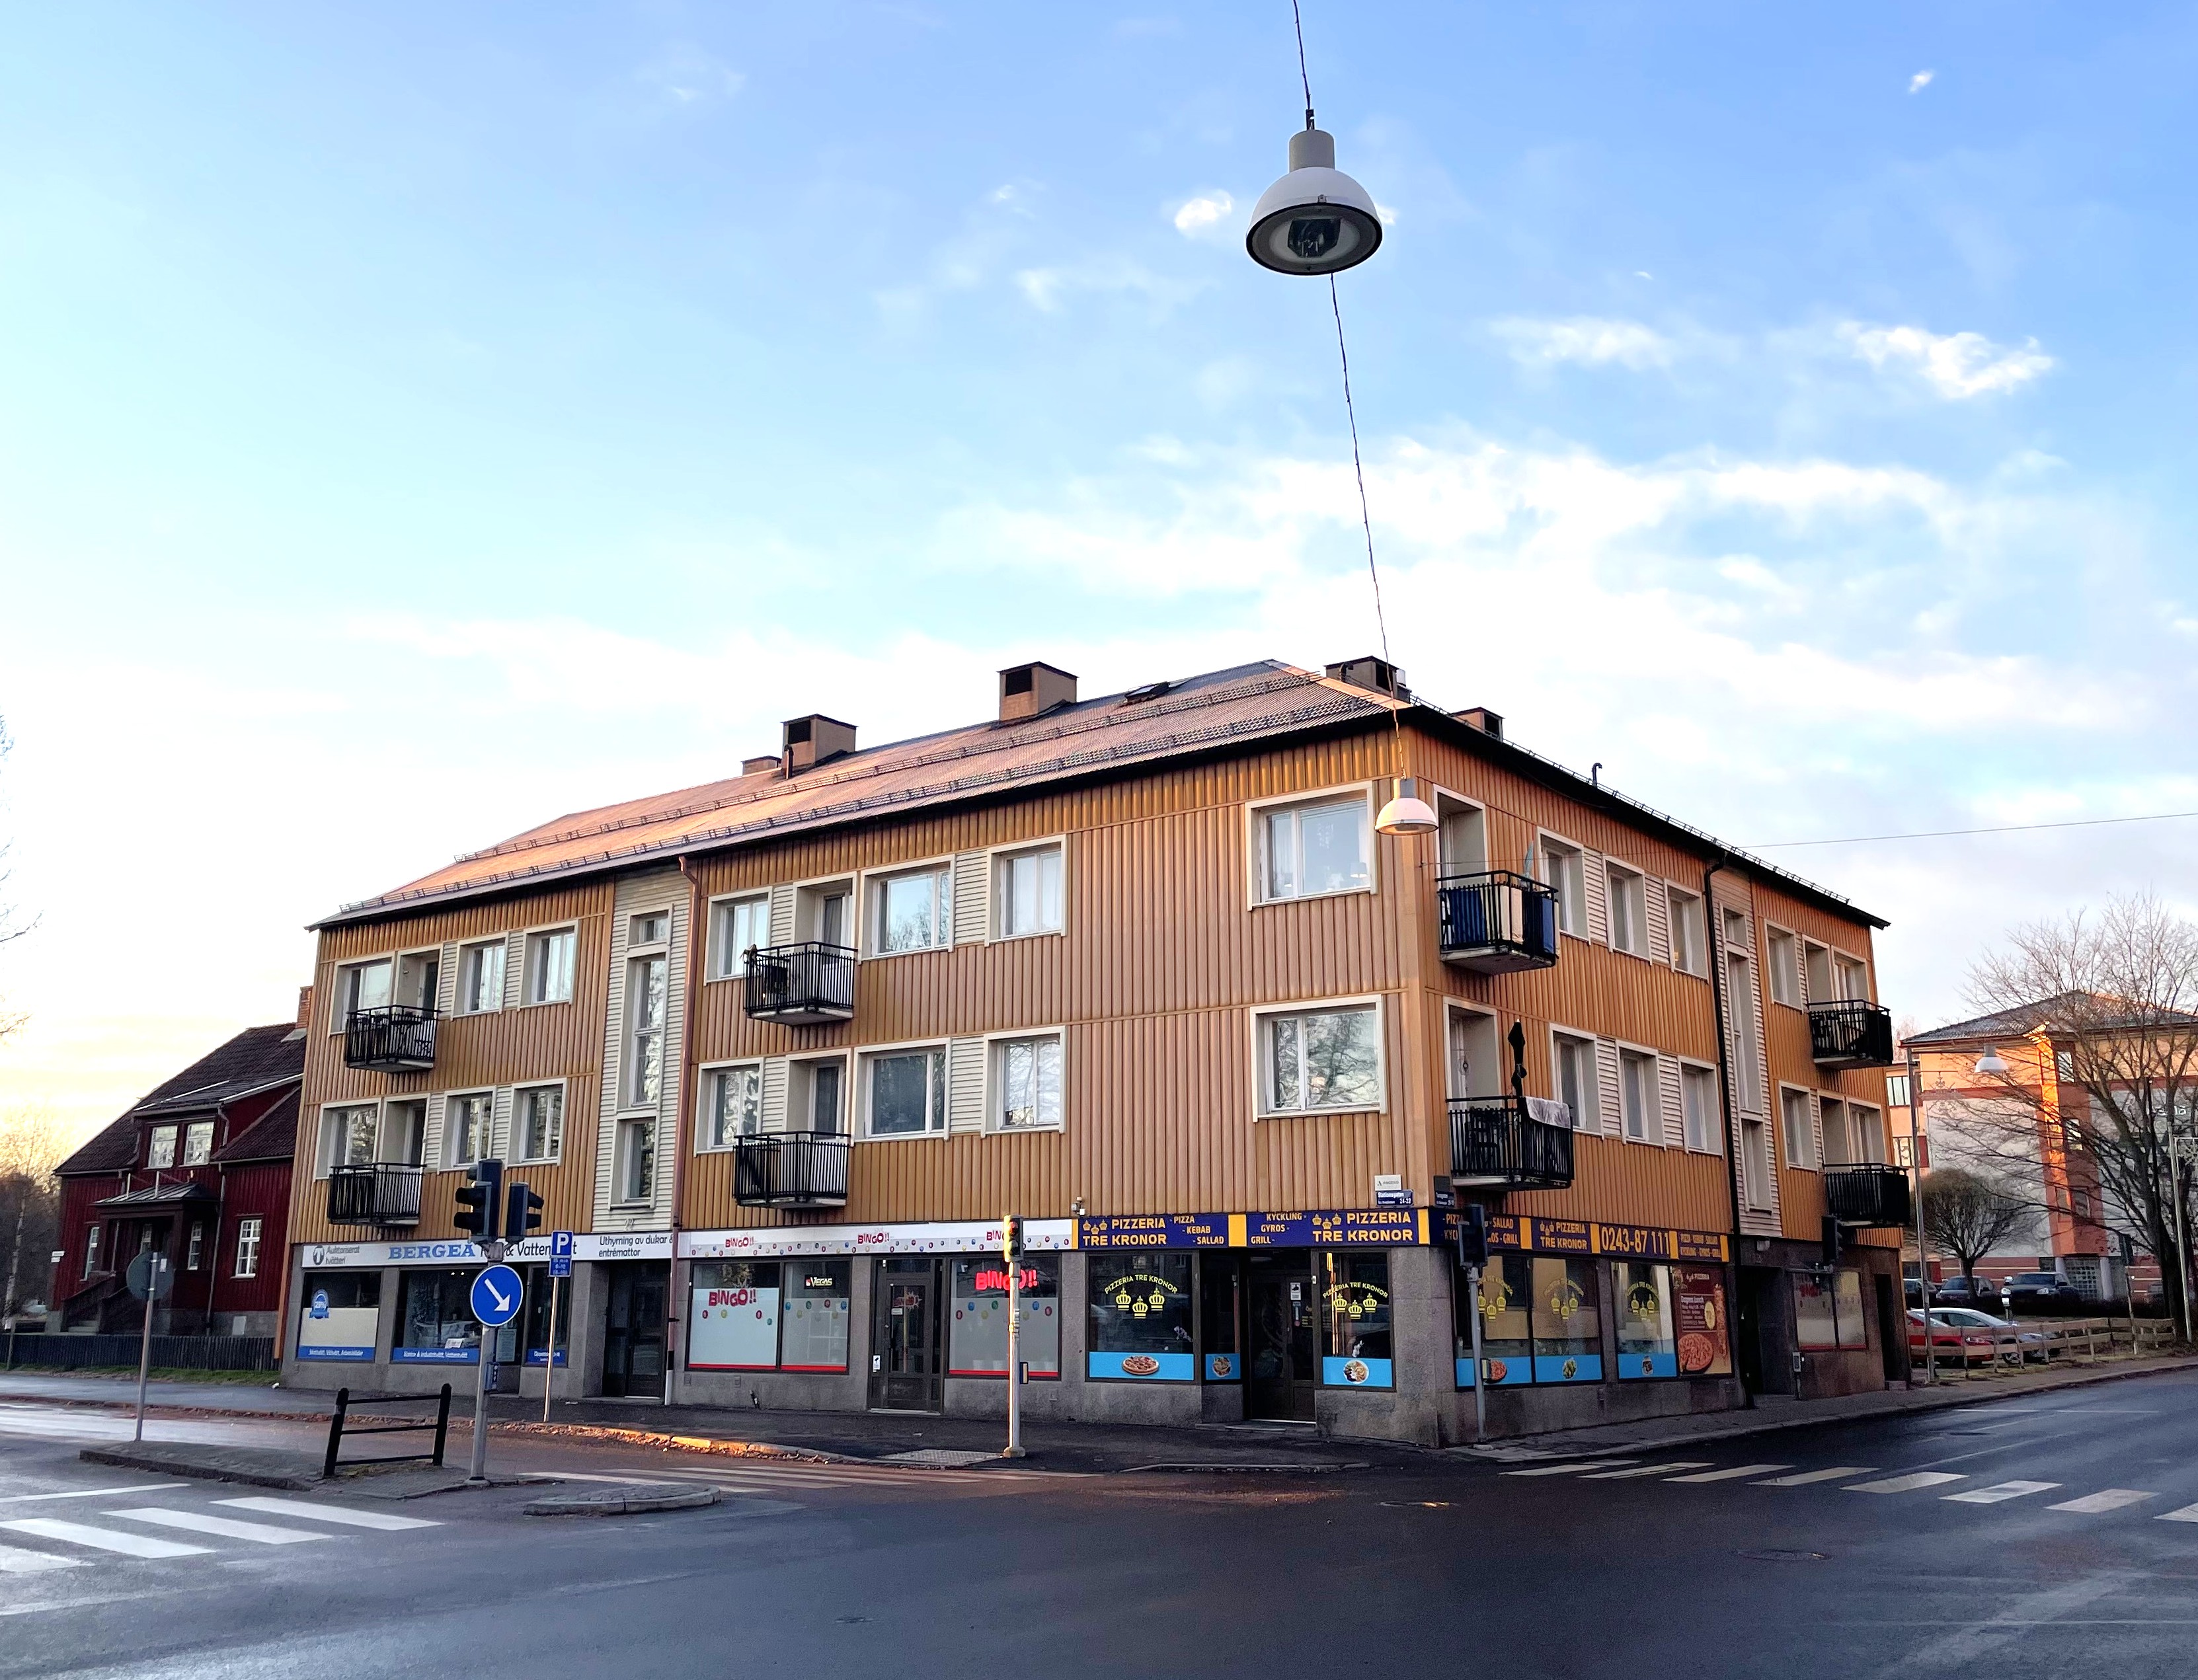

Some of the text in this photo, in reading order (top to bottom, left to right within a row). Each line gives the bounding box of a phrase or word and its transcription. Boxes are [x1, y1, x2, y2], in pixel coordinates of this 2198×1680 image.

[1266, 1212, 1302, 1221] KYCKLING
[1347, 1211, 1411, 1224] PIZZERIA
[1111, 1218, 1166, 1230] PIZZERIA
[1261, 1224, 1285, 1233] GYROS
[1493, 1217, 1514, 1229] SALLAD
[1555, 1221, 1586, 1235] PIZZERIA
[646, 1235, 668, 1244] dukar
[857, 1232, 890, 1244] BINGO!!
[1082, 1234, 1167, 1246] TRE KRONOR
[1197, 1236, 1224, 1244] SALLAD
[1251, 1236, 1271, 1244] GRILL
[1312, 1229, 1413, 1242] TRE KRONOR
[1503, 1233, 1518, 1244] GRILL
[1601, 1226, 1648, 1254] 0243-87
[1651, 1230, 1670, 1254] 111
[557, 1233, 569, 1254] P
[1540, 1236, 1587, 1250] TRE KRONOR
[388, 1241, 475, 1260] BERGEÅ
[598, 1247, 641, 1257] entrémattor
[810, 1277, 833, 1287] VEGAS
[1104, 1276, 1134, 1294] PIZZERIA
[1149, 1276, 1178, 1294] KRONOR
[1362, 1283, 1388, 1299] KRONOR
[708, 1289, 757, 1307] BINGO!!
